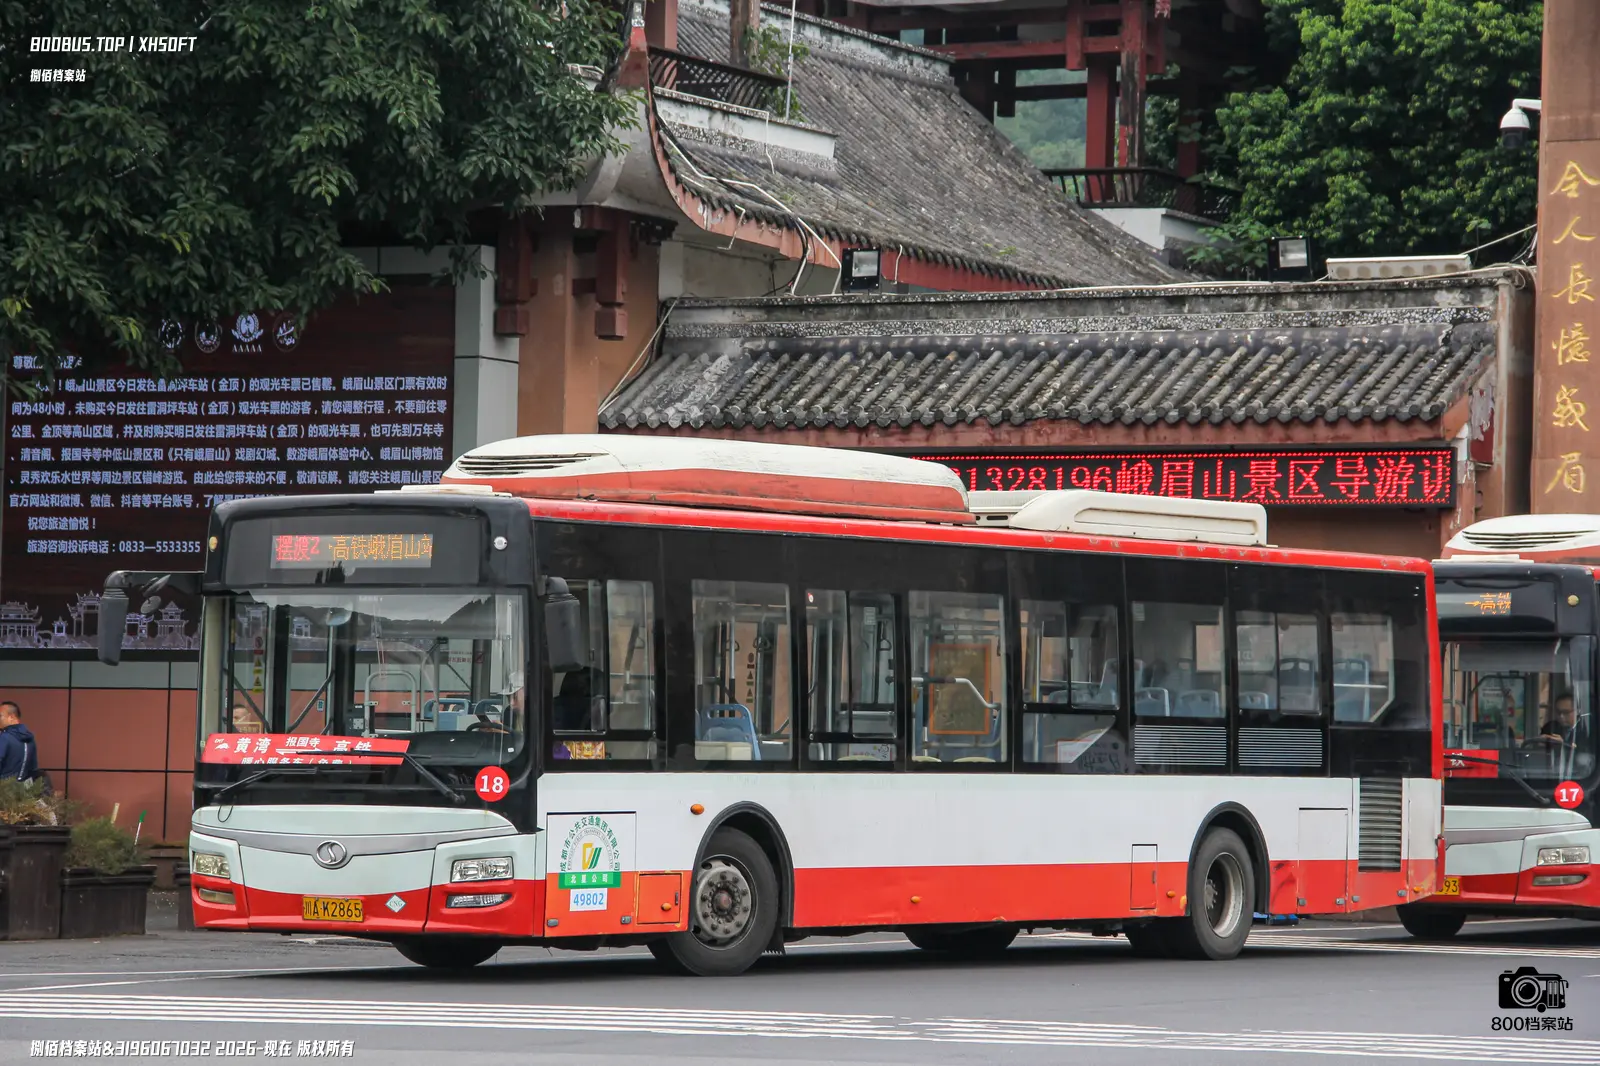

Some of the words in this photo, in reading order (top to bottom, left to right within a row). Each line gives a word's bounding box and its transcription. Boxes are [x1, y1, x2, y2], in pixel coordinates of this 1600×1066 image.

[950, 456, 1447, 500] 1328196峨眉山景区导游讲
[28, 516, 96, 531] 祝您旅途愉悦！
[275, 535, 321, 561] 摆渡2
[234, 737, 271, 754] 黄湾
[285, 736, 321, 748] 报国寺
[479, 774, 504, 794] 18
[1558, 787, 1580, 803] 17
[1439, 880, 1458, 893] 93
[573, 893, 605, 907] 49802
